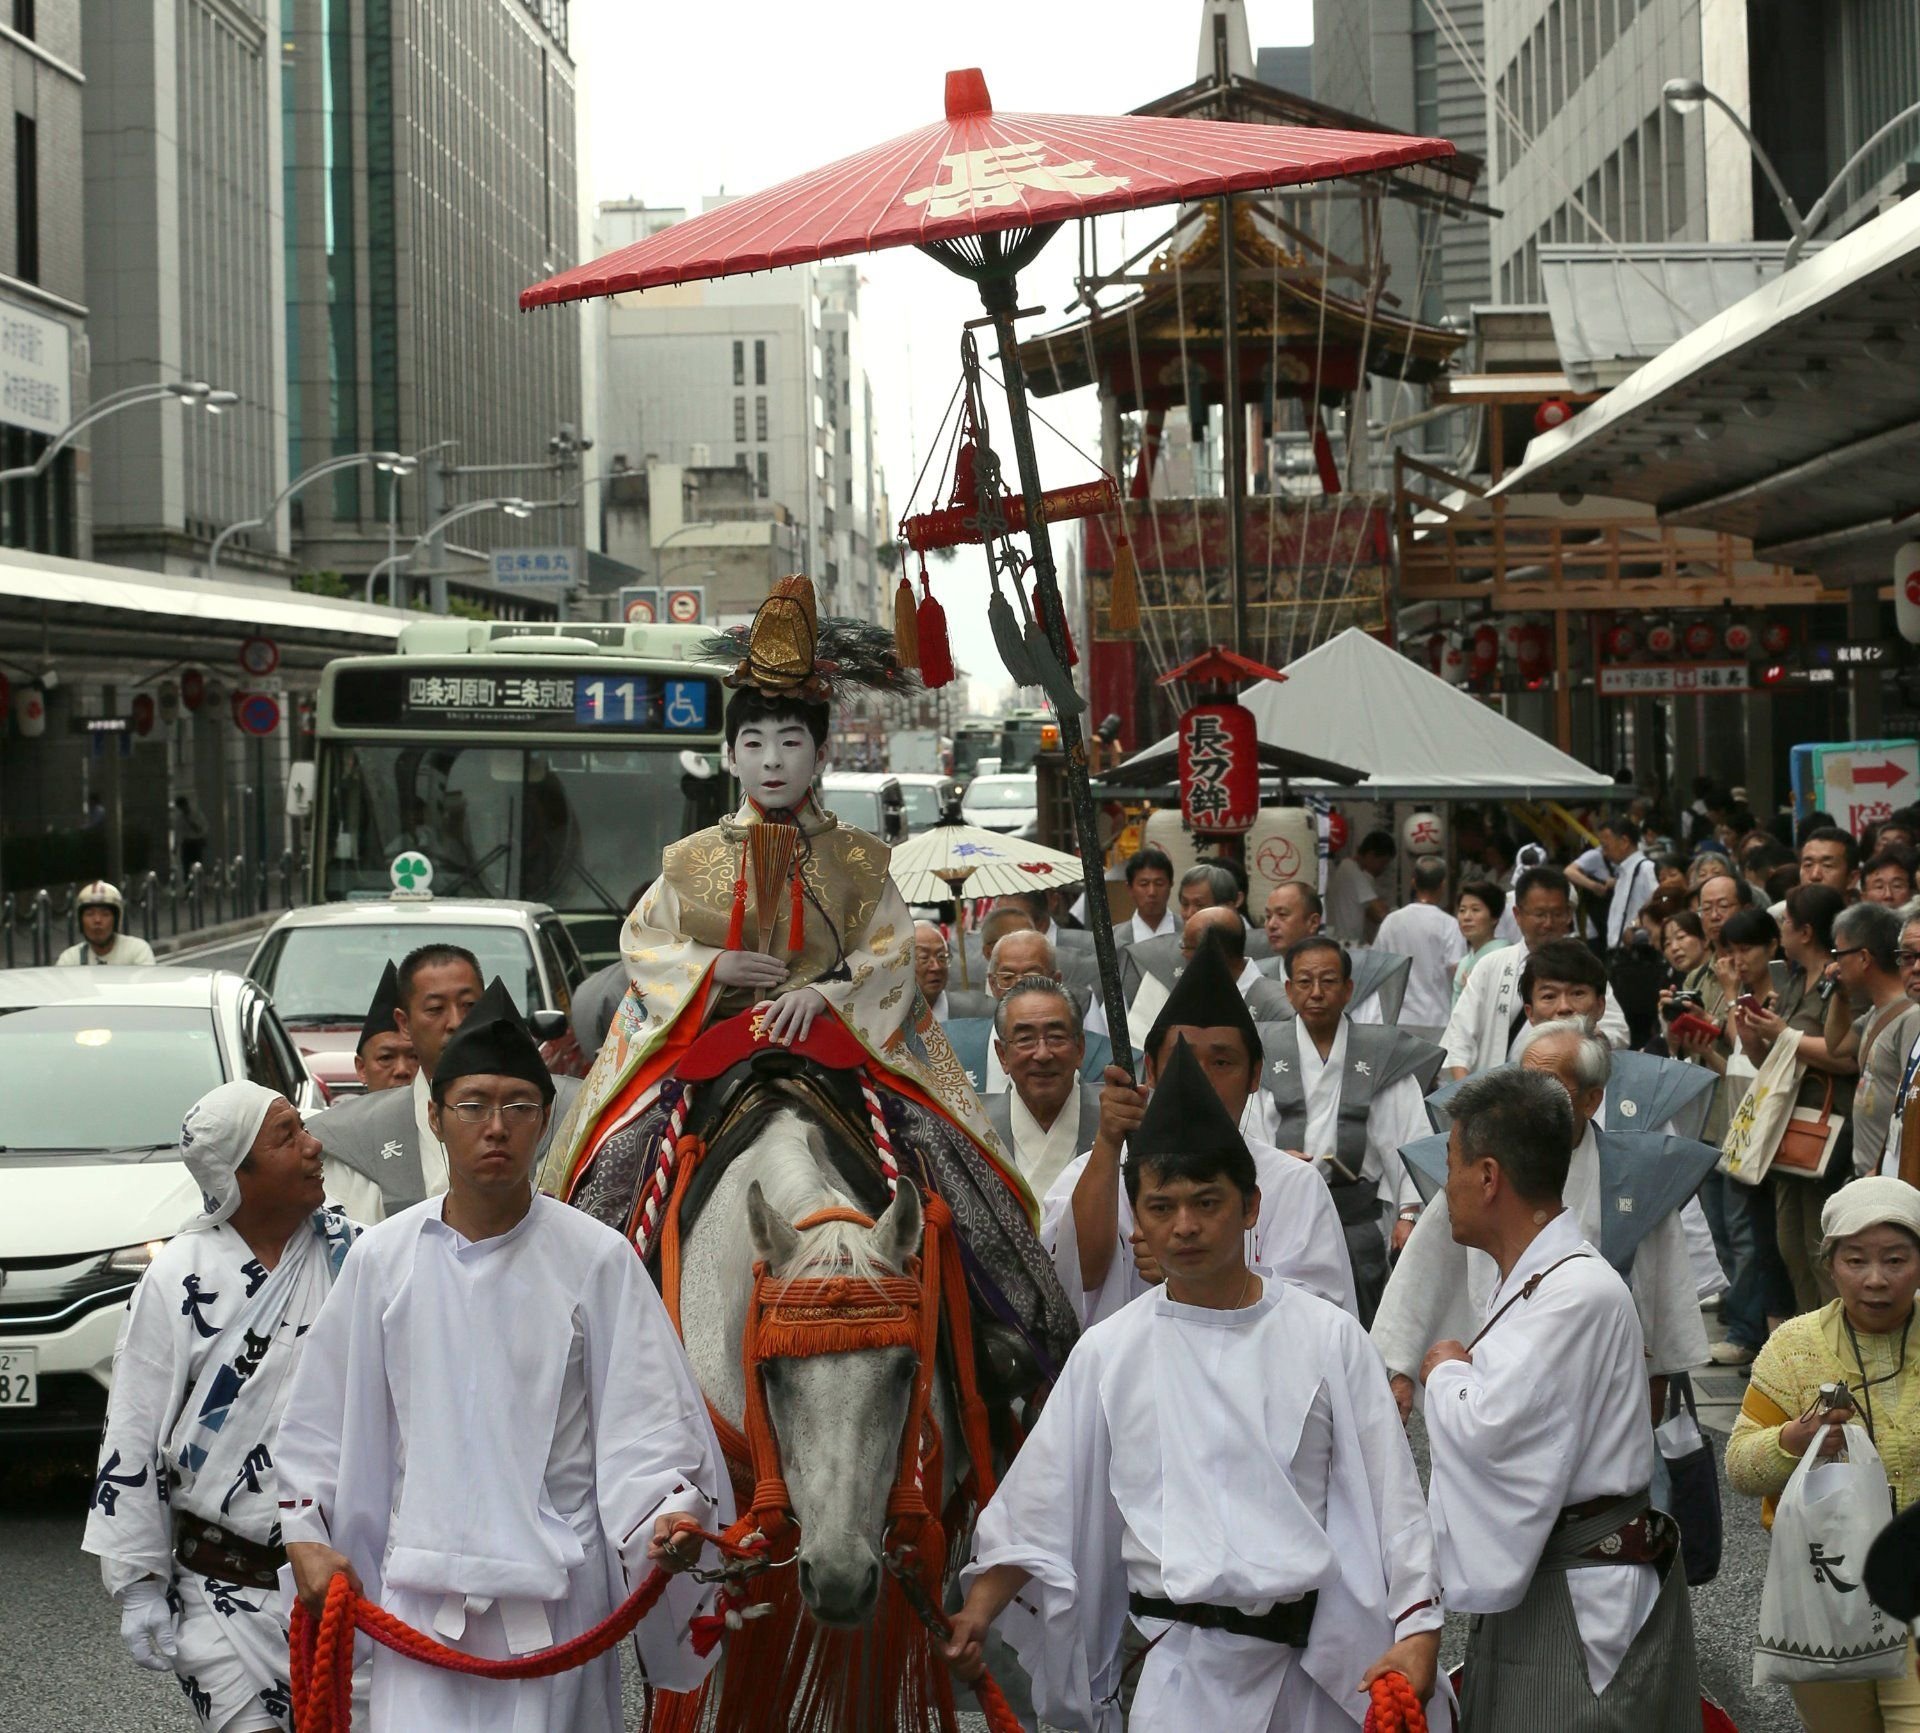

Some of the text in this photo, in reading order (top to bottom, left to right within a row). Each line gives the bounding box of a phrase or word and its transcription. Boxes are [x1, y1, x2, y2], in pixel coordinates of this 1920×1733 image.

[902, 141, 1133, 217] 長
[496, 555, 569, 572] 四条烏丸
[409, 677, 635, 721] 四条河原町・三条京阪 11
[1187, 715, 1233, 823] 長刀鉾
[1498, 963, 1514, 1016] 長刀鉾
[380, 1140, 403, 1160] 長
[1808, 1543, 1860, 1594] 長
